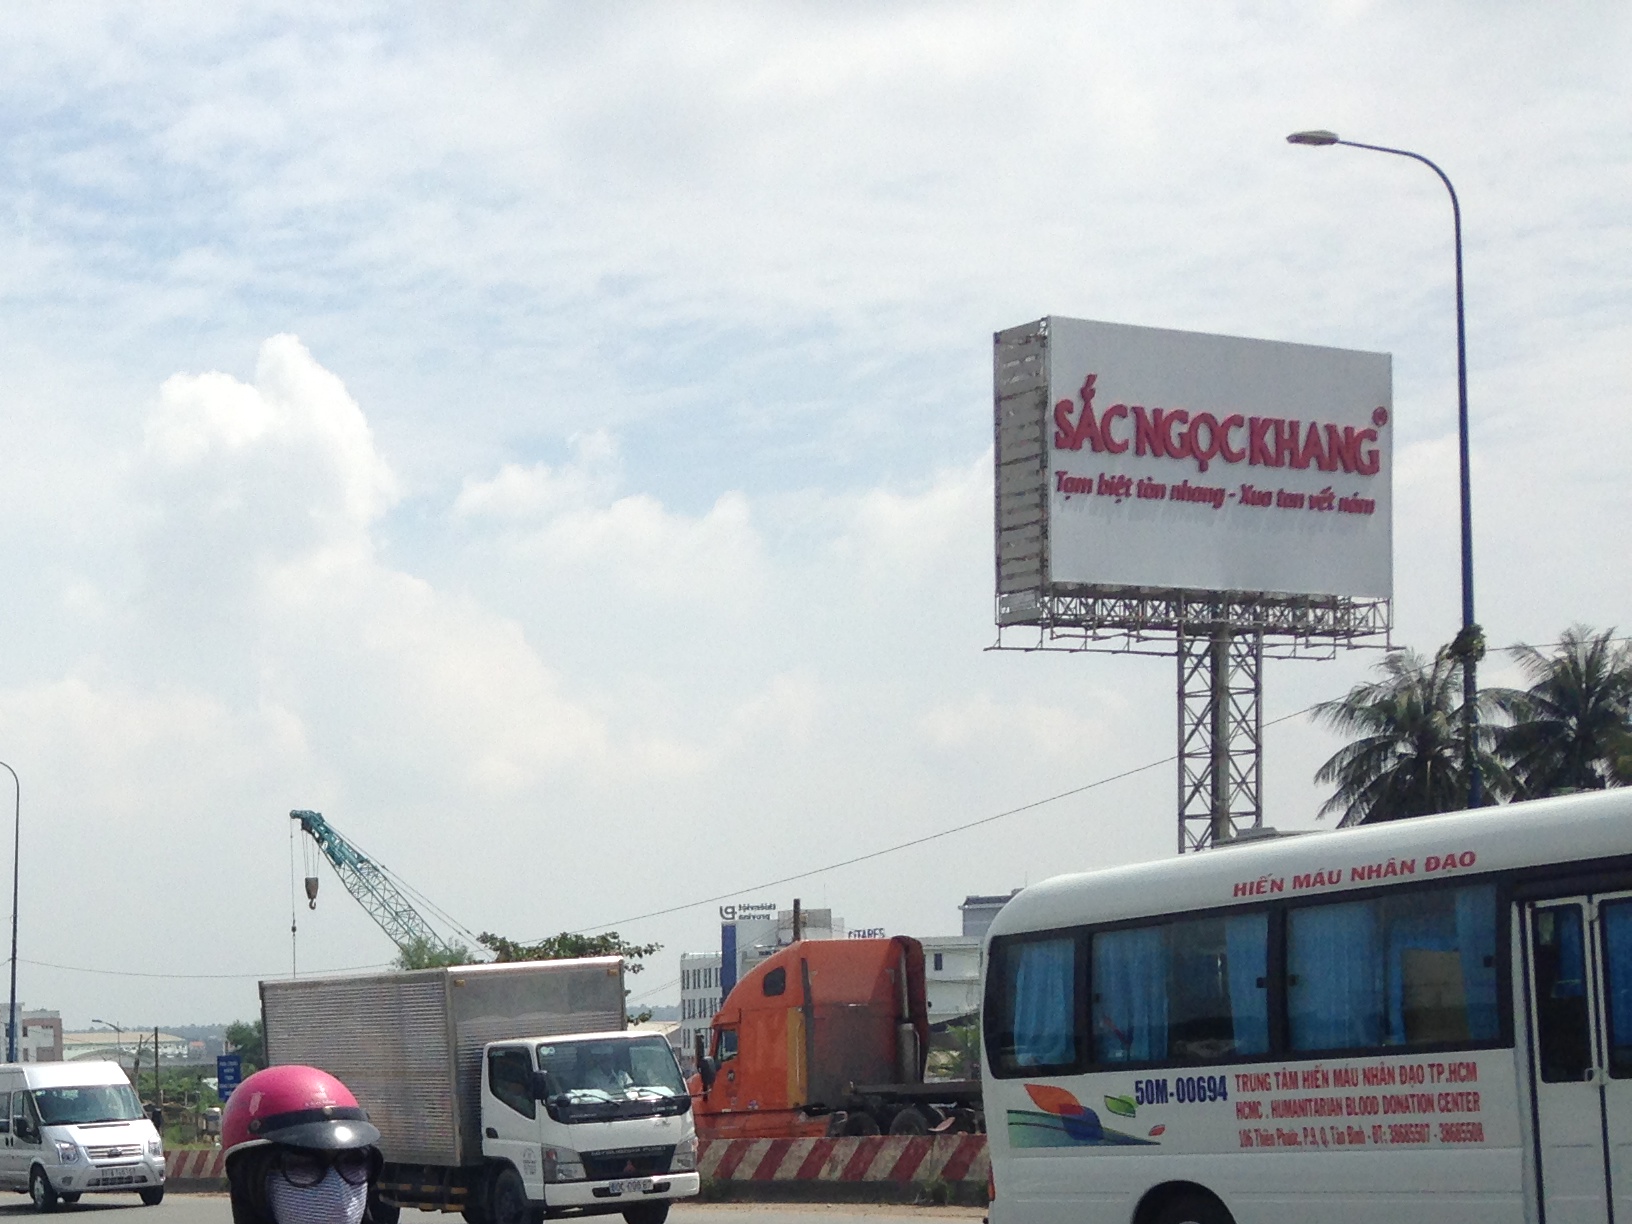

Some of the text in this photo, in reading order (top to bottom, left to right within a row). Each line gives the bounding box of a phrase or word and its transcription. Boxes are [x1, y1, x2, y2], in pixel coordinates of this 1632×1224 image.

[1055, 471, 1093, 500] Tạm
[1097, 472, 1133, 503] biệt
[1233, 850, 1477, 897] HIẾN MÁU NHÂN ĐẠO
[1134, 1075, 1228, 1105] 50M-00694
[1235, 1072, 1272, 1092] TRUNG
[1274, 1067, 1298, 1090] TÂM
[1302, 1064, 1329, 1089] HIẾN
[1333, 1063, 1359, 1088] MÁU
[1362, 1061, 1395, 1086] NHÂN
[1399, 1064, 1424, 1088] ĐẠO
[1271, 1097, 1343, 1119] HUMANITARIAN
[1345, 1095, 1379, 1116] BLOOD
[1382, 1093, 1435, 1115] DONATION
[1438, 1091, 1481, 1114] CENTER
